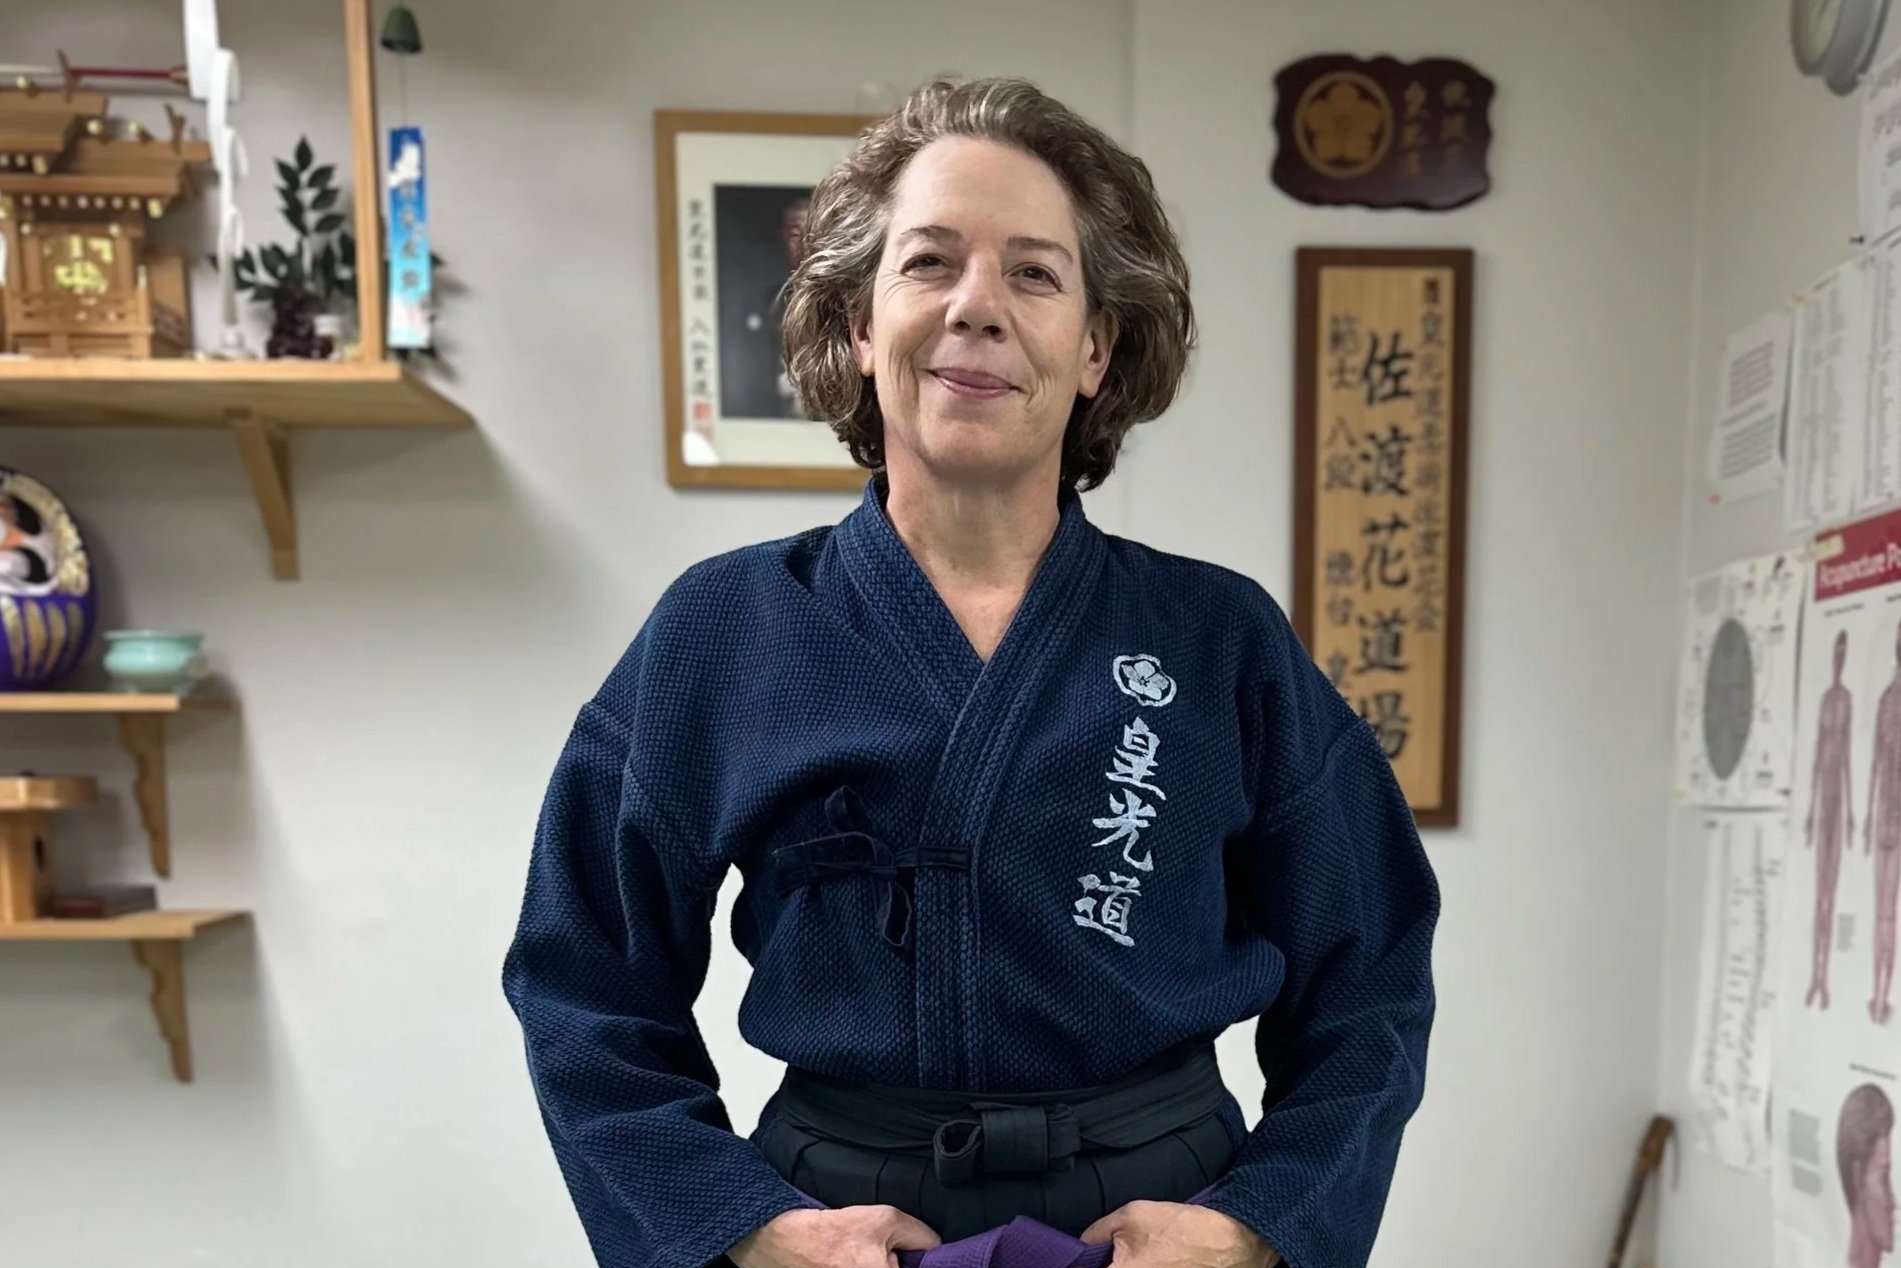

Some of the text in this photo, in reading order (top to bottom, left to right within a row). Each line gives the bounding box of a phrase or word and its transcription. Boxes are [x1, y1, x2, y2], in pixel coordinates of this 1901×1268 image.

[1887, 541, 1901, 571] P
[1073, 716, 1167, 947] 皇光道
